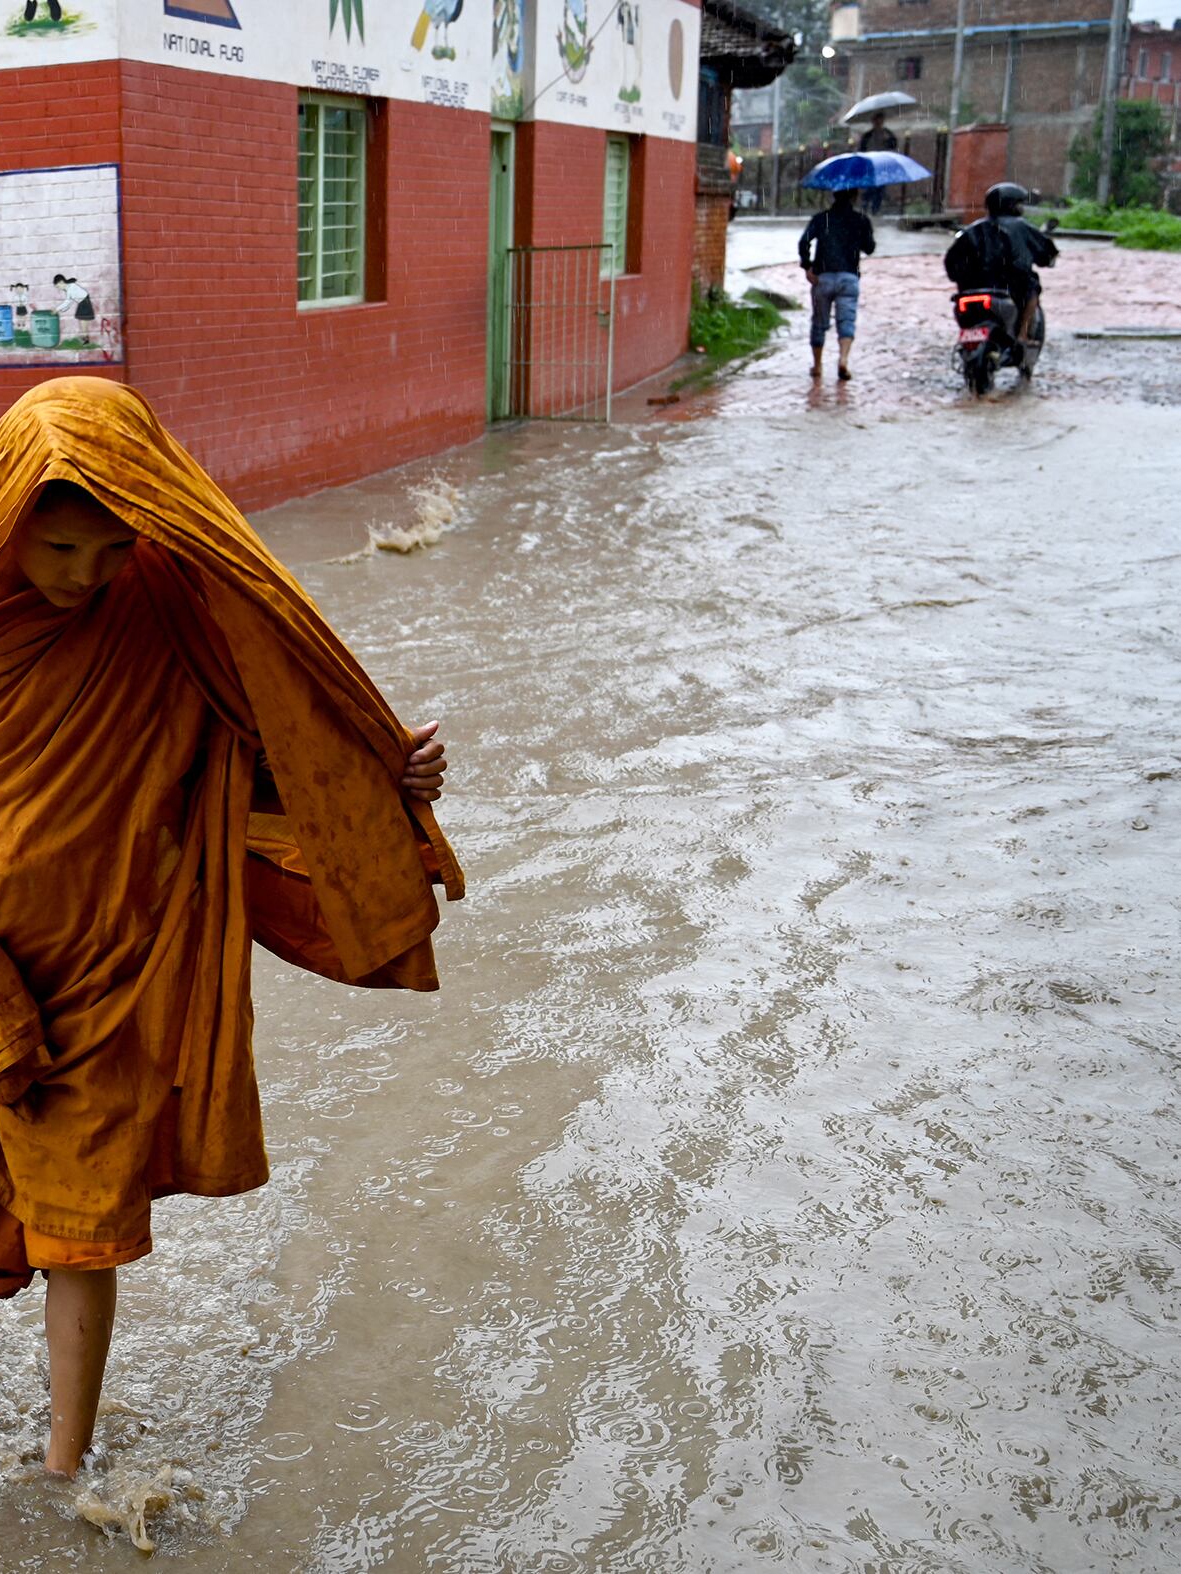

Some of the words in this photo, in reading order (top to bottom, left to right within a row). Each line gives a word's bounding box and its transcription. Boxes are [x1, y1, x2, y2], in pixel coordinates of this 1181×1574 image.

[163, 32, 215, 58] NATIONAL
[219, 44, 244, 63] FLAG
[311, 59, 349, 78] NATIONAL
